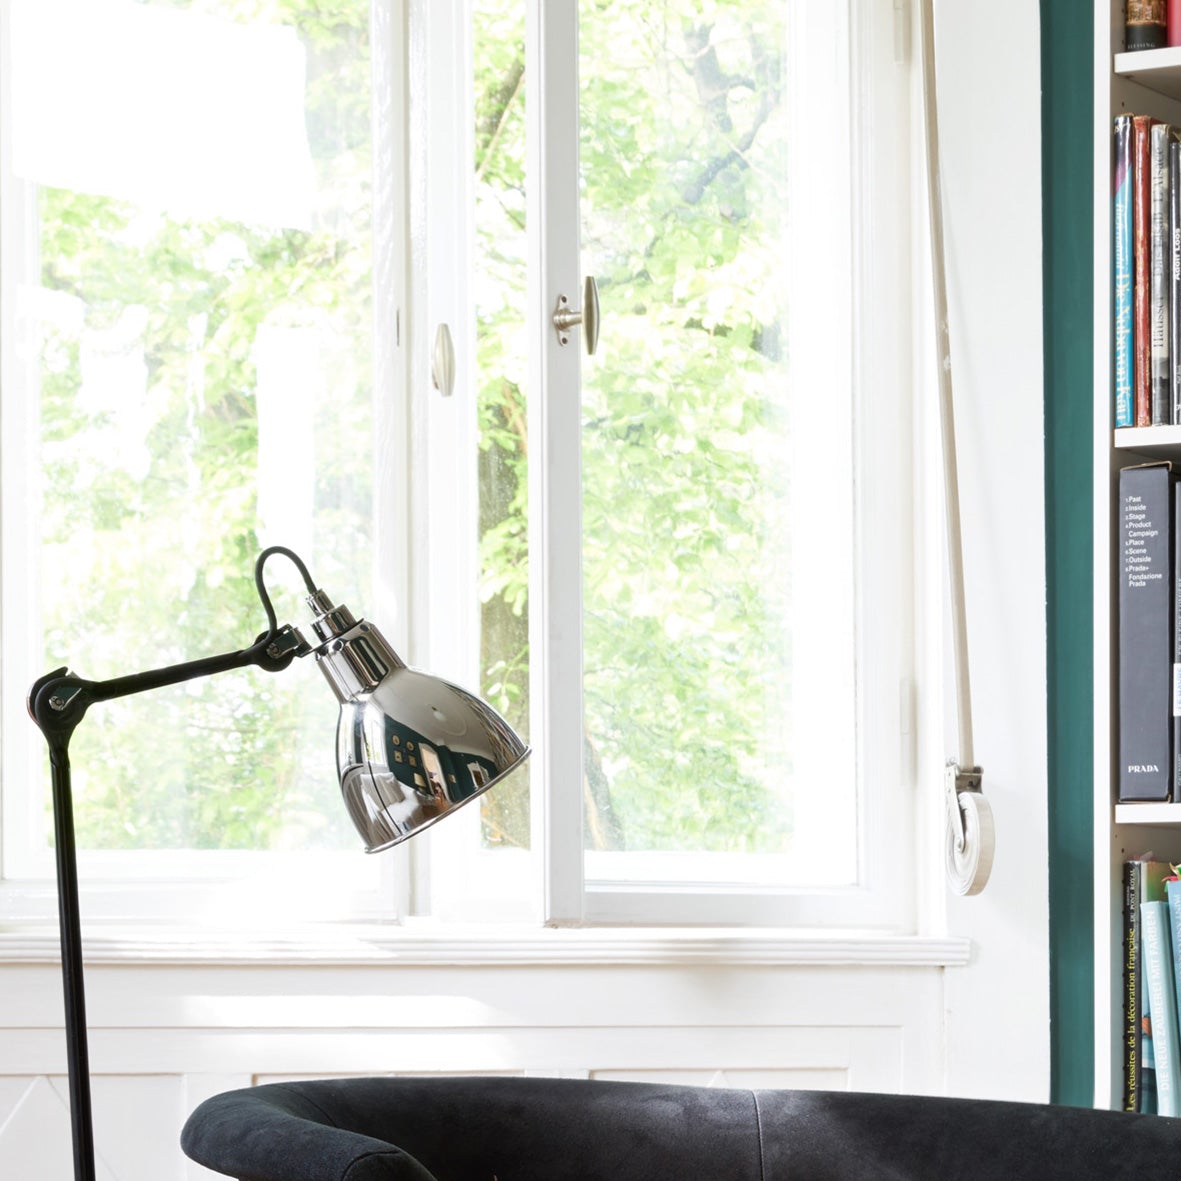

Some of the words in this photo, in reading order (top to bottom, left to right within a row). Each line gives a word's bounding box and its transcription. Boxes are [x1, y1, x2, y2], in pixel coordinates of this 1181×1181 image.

[1146, 910, 1160, 955] FARBEN
[1151, 957, 1161, 978] MIT
[1127, 971, 1137, 1021] décoration
[1153, 981, 1167, 1038] ZAUBEREI
[1127, 1036, 1136, 1049] de
[1158, 1040, 1169, 1069] NEUE
[1127, 1054, 1136, 1091] réussites
[1160, 1072, 1170, 1091] DIE
